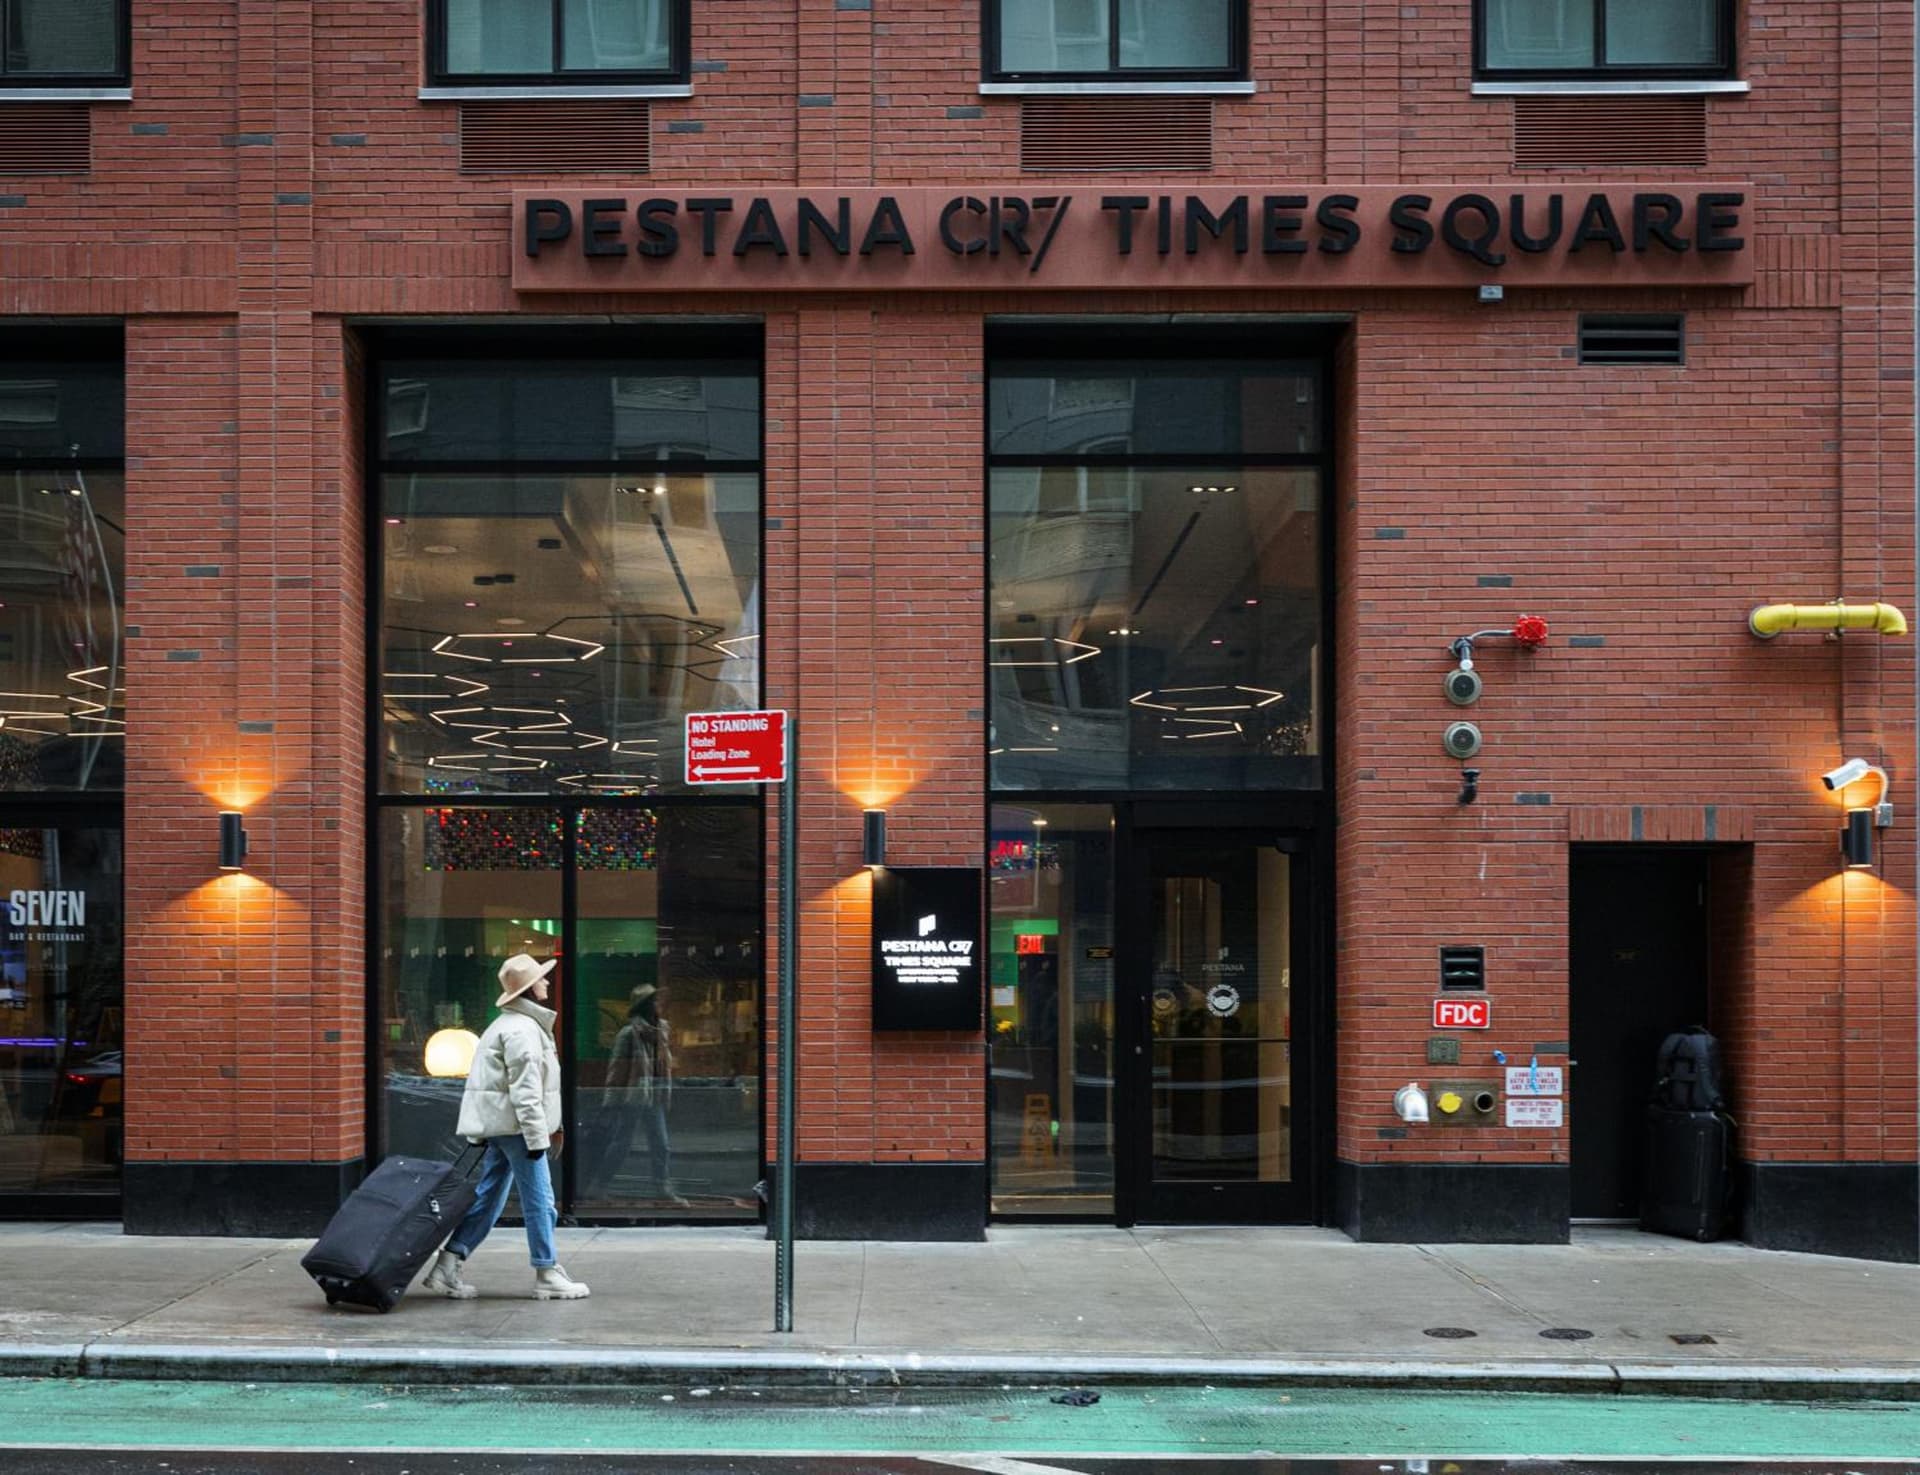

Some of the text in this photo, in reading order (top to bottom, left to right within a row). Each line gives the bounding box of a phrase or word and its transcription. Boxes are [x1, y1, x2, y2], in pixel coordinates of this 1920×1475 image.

[524, 191, 1746, 273] PESTANA CR7 TIMES SQUARE
[691, 718, 769, 733] NO STANDING
[691, 737, 716, 747] Hotel
[691, 748, 751, 761] Loading Zone
[10, 890, 86, 926] SEVEN
[881, 940, 947, 952] PESTANA
[1440, 1004, 1483, 1024] FDC
